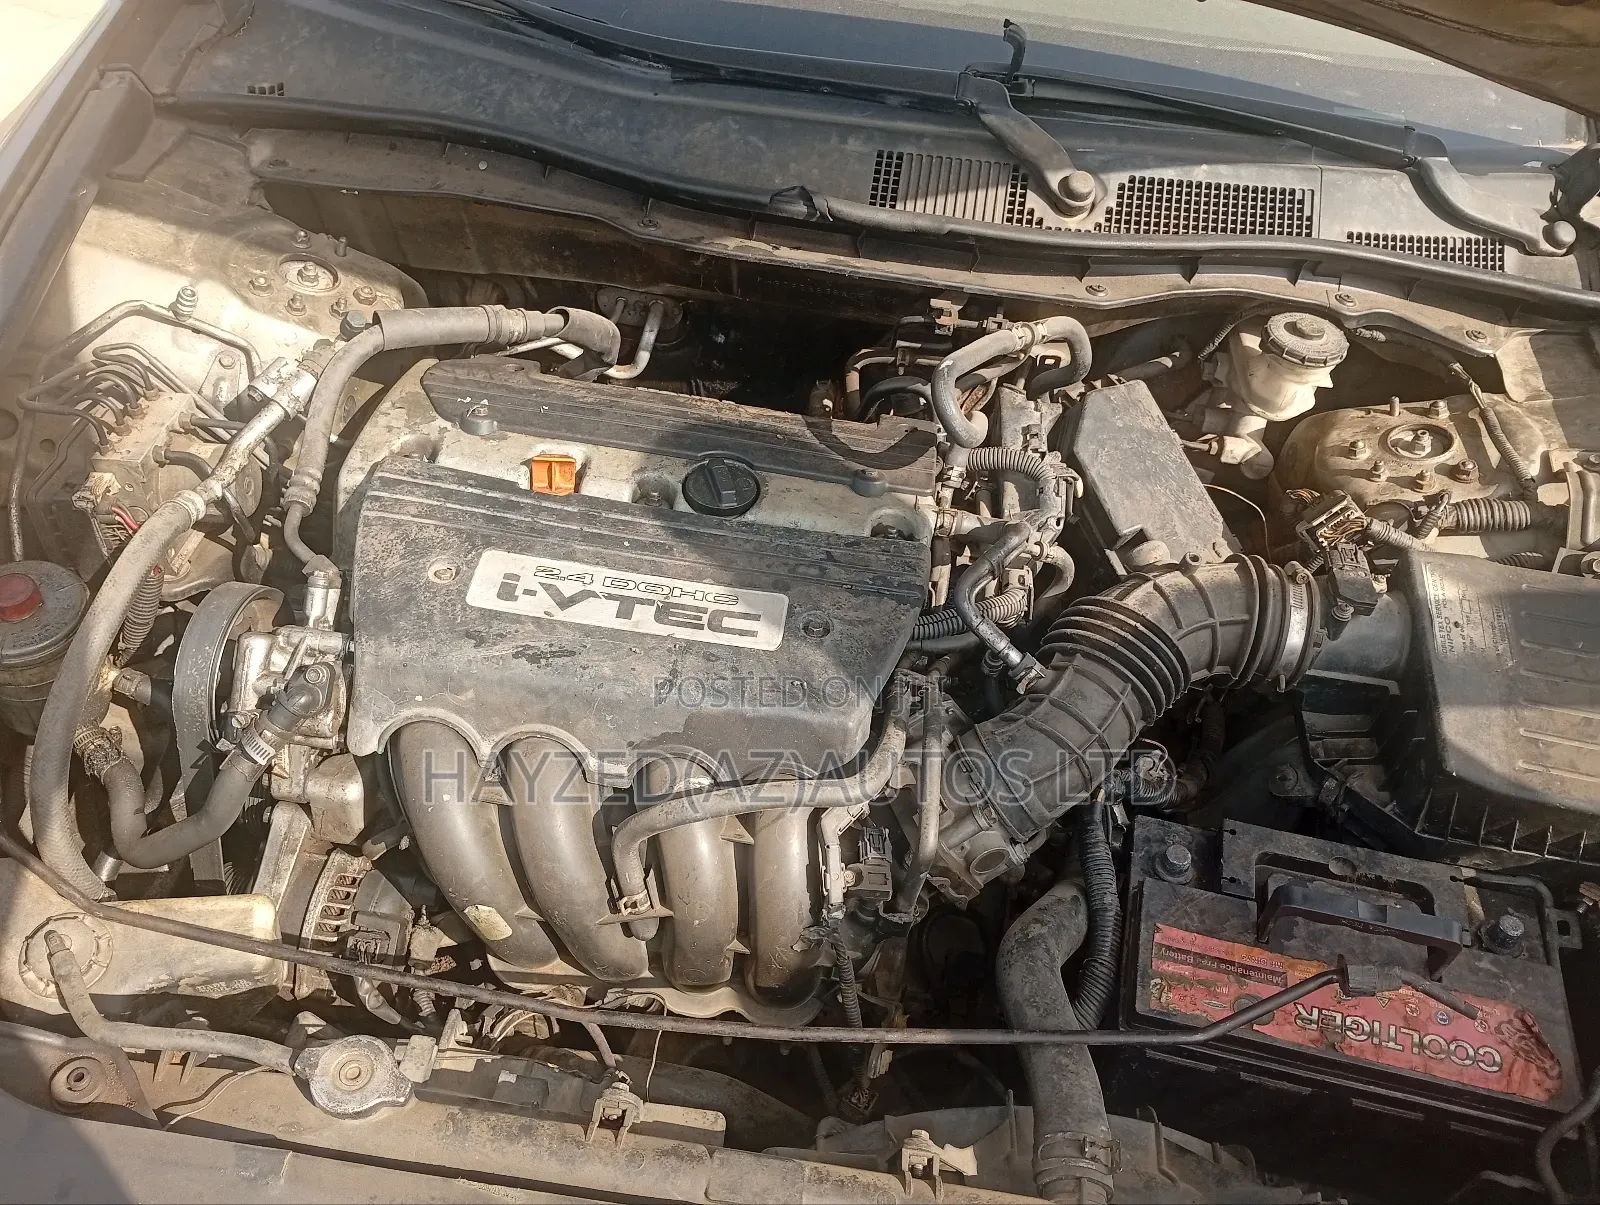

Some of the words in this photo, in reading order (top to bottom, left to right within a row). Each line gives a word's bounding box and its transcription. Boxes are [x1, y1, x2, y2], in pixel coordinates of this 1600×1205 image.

[496, 572, 761, 638] i-VTEC
[534, 566, 594, 586] 2.4
[602, 575, 738, 606] DOHC
[1444, 616, 1455, 652] NIPCO
[1159, 946, 1195, 964] Battery
[1221, 961, 1283, 984] Maintenance
[1294, 1002, 1504, 1073] COOLTIGER
